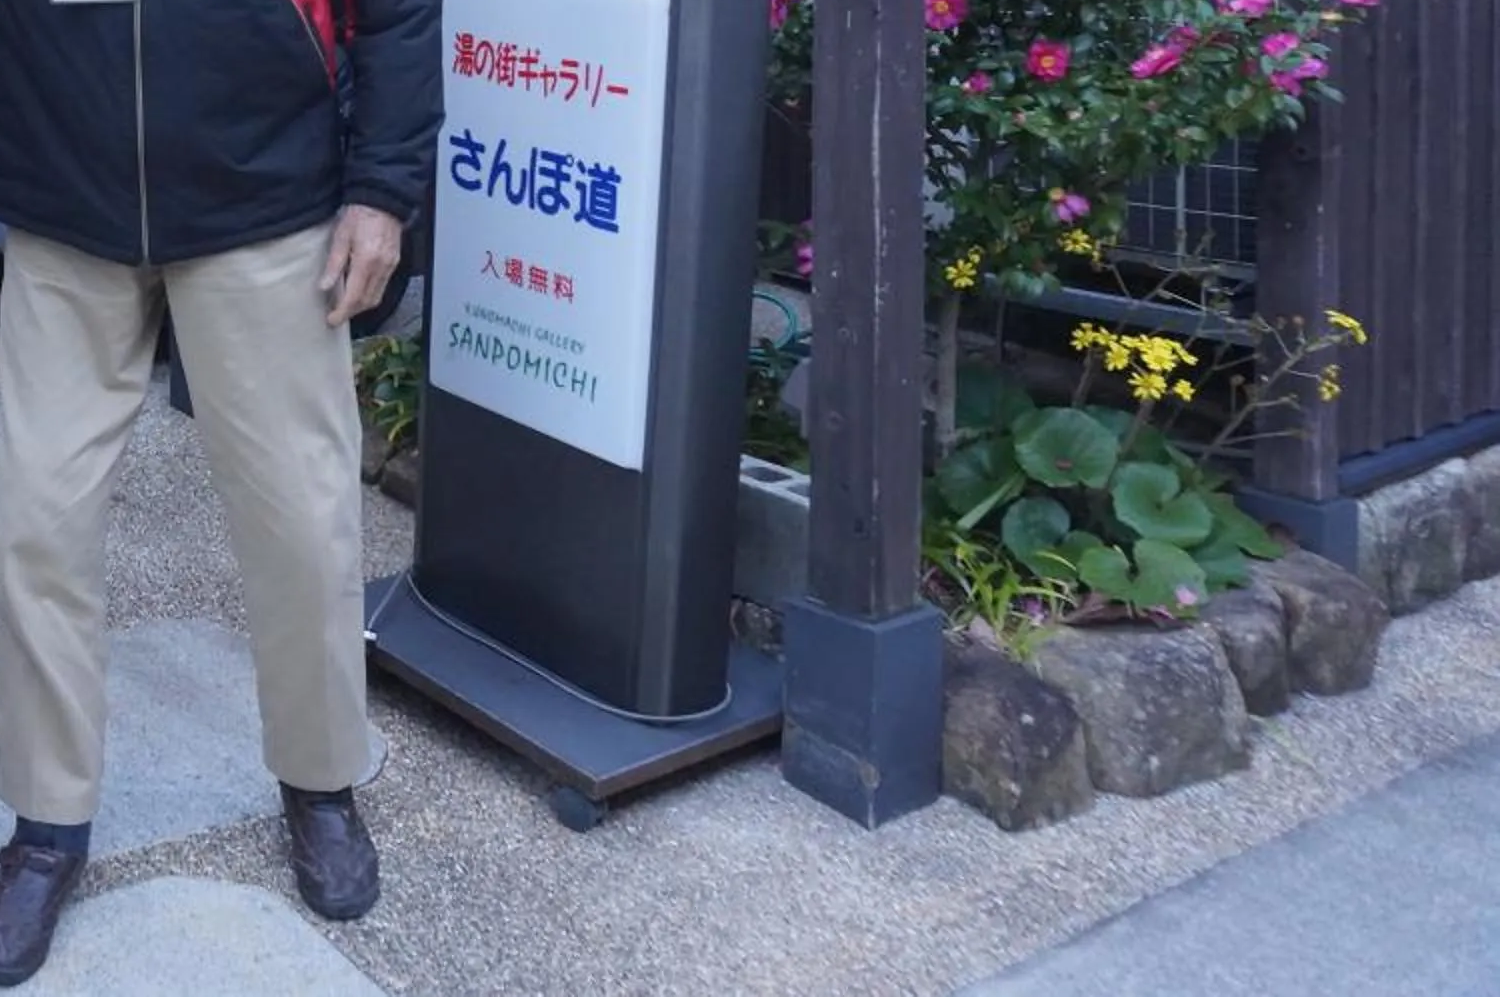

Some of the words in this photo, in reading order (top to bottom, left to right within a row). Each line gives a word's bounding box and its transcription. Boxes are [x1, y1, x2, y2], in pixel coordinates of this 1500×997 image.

[451, 32, 629, 108] 湯の街ギャラリー
[449, 128, 622, 233] さんぽ道
[480, 250, 574, 304] 入場無料
[449, 321, 597, 403] SANPOMICHI
[535, 327, 586, 354] GALLERY
